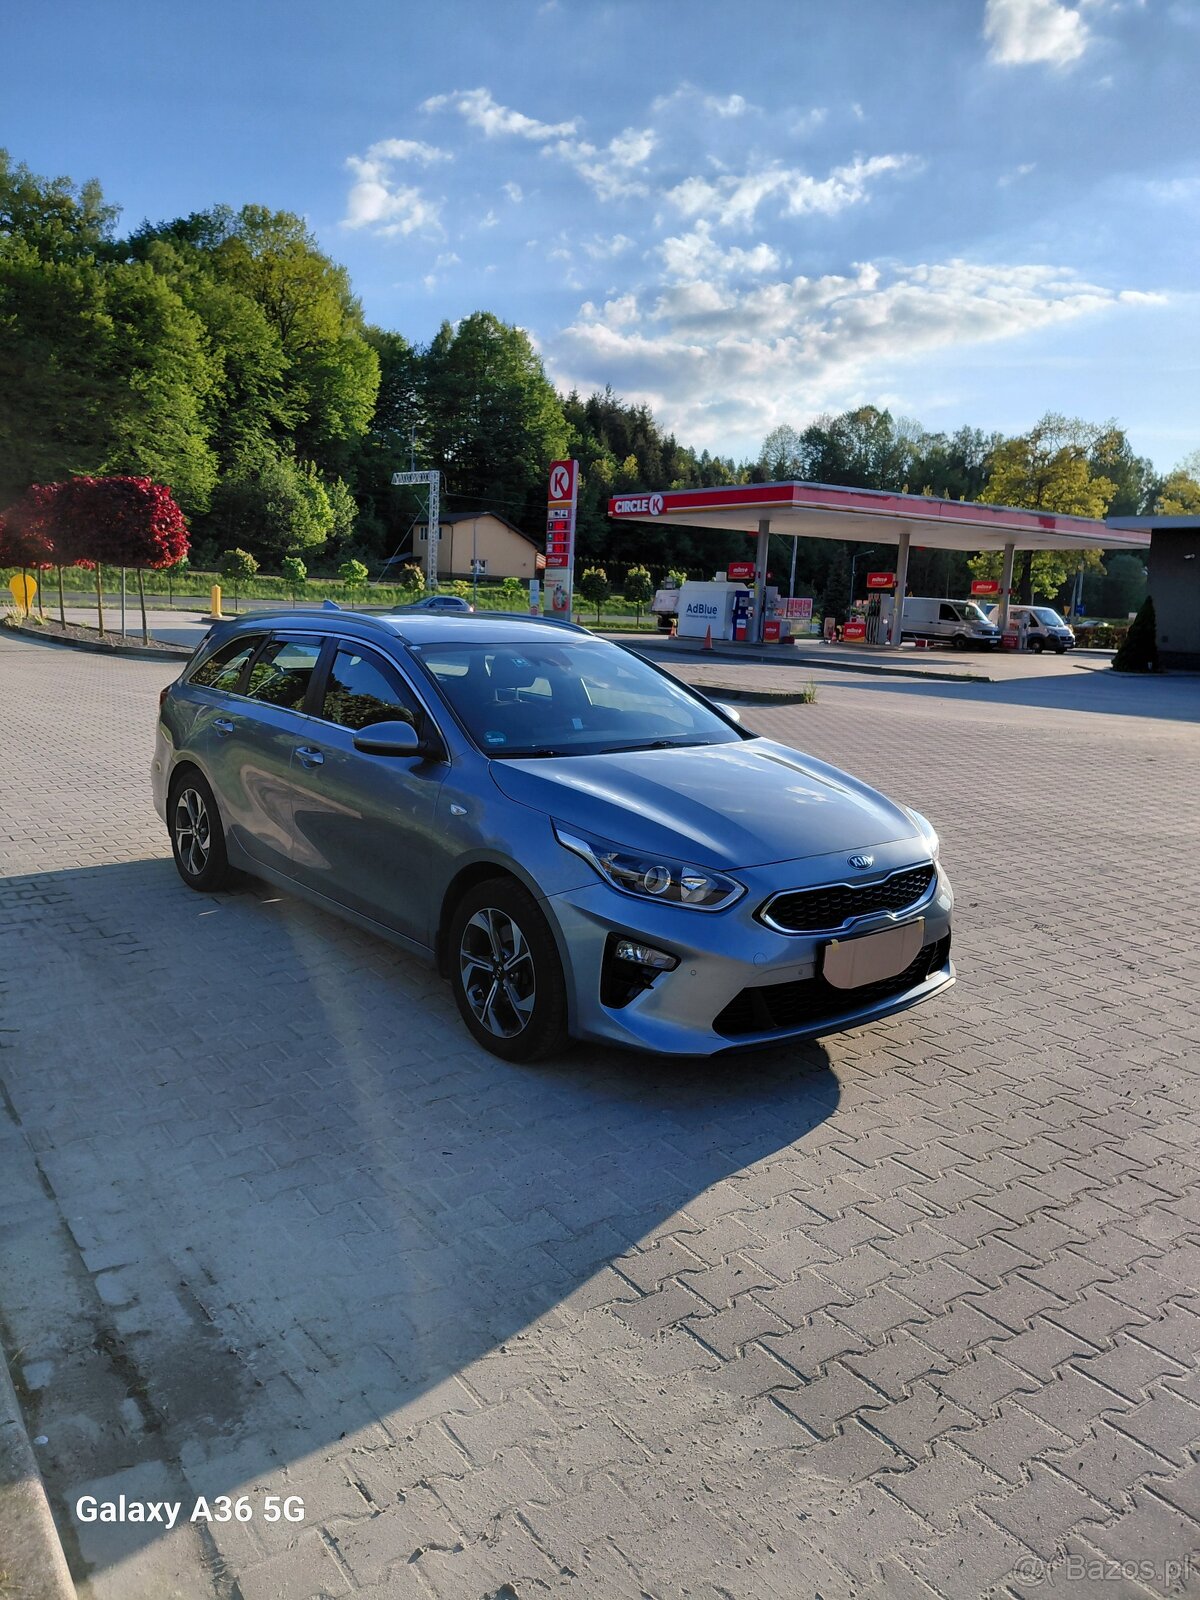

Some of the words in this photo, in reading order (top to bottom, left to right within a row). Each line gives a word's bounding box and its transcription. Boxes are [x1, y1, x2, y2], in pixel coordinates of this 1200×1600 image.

[553, 470, 568, 496] K
[615, 500, 648, 513] CIRCLE
[686, 603, 718, 615] AdBlue
[851, 856, 872, 867] KIA
